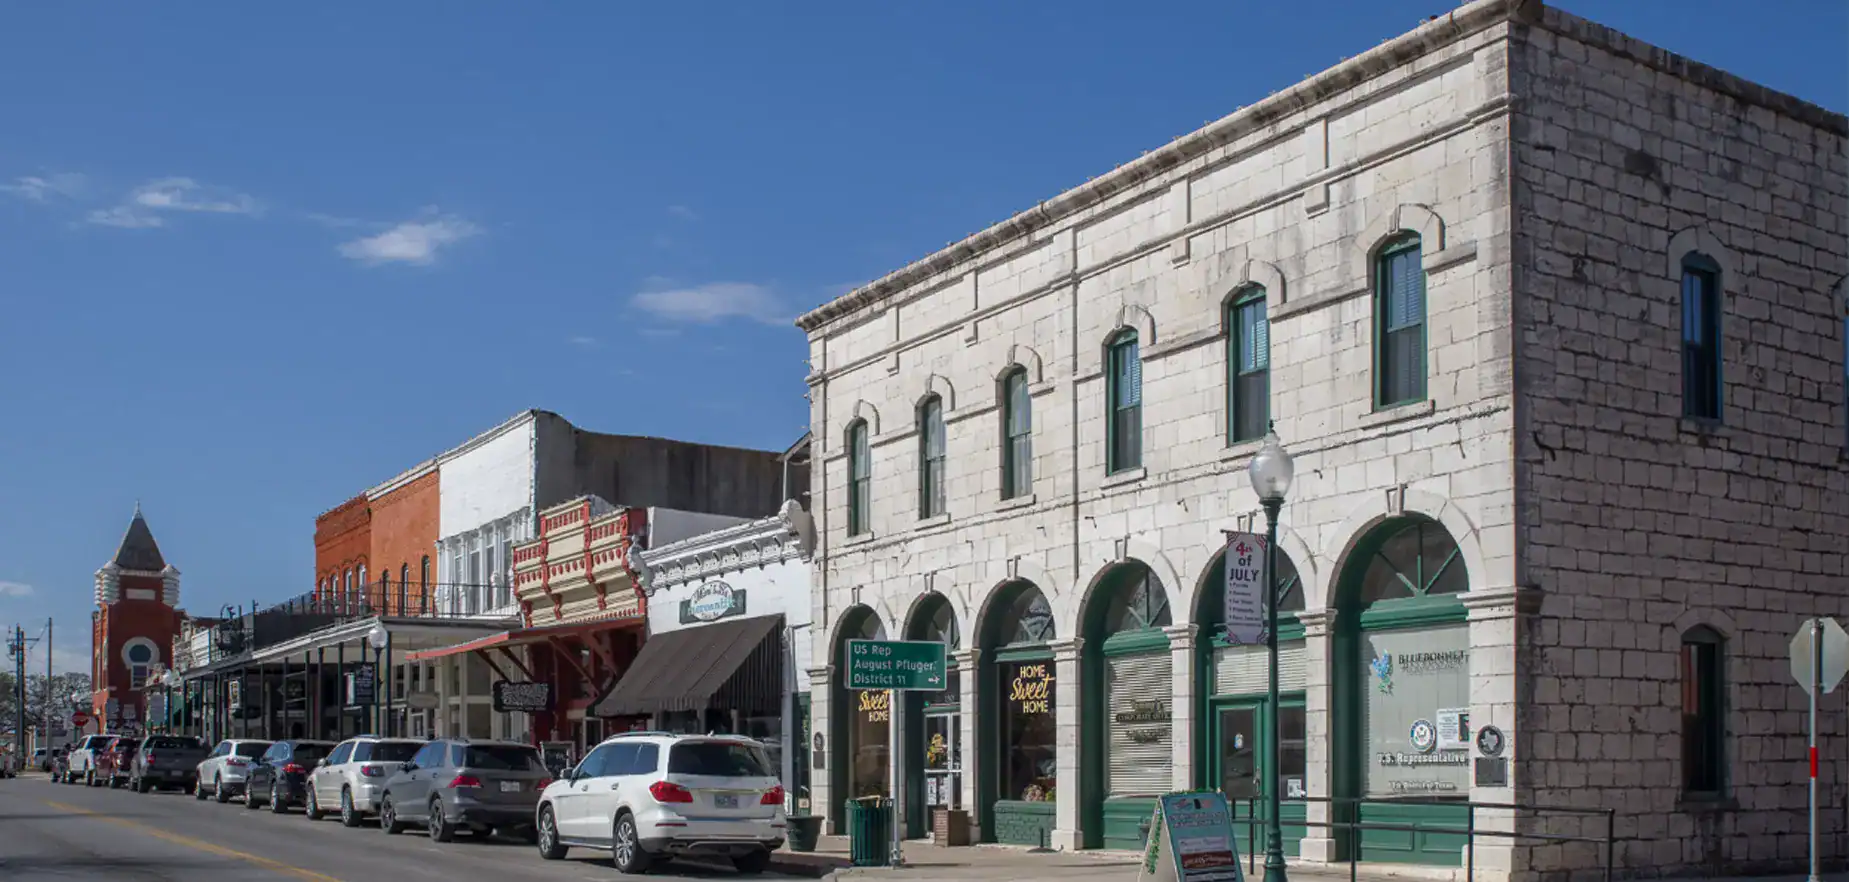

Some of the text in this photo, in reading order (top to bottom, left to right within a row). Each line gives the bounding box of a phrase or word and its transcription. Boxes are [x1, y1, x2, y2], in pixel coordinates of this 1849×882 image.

[1235, 542, 1253, 556] 4th
[1238, 555, 1252, 567] of
[1230, 568, 1260, 582] JULY
[853, 644, 892, 657] US Rep
[1398, 650, 1466, 664] BLUEBONNET
[854, 660, 934, 673] August Pfluger
[1020, 664, 1046, 678] HOME
[853, 673, 906, 685] District 11
[1010, 673, 1056, 701] Sweet
[858, 690, 890, 711] Sweet
[1023, 700, 1049, 714] HOME
[869, 710, 888, 722] HOME
[1377, 752, 1466, 765] U.S. Representative
